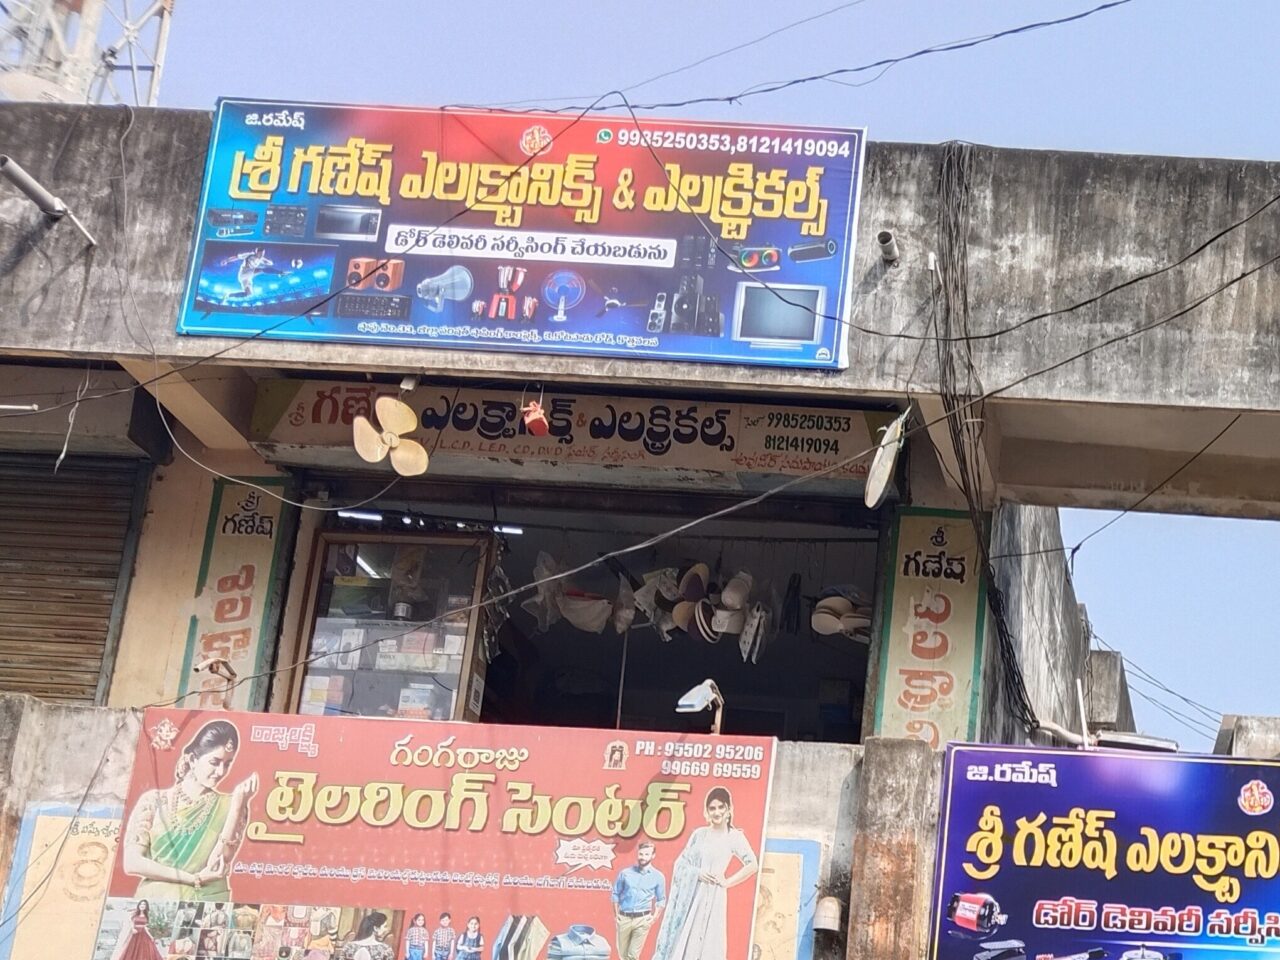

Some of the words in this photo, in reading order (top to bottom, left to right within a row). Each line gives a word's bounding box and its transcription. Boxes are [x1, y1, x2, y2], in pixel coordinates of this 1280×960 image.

[228, 135, 284, 201] శ్రీ
[286, 136, 394, 206] గణేష్
[612, 167, 636, 211] &
[432, 233, 488, 250] డెలివరీ
[491, 236, 568, 258] సర్వీసింగ్
[570, 240, 668, 261] చేయబడును
[767, 411, 852, 433] 9985250353
[765, 435, 840, 455] 8121419094
[390, 734, 530, 771] గంగరాజు
[664, 742, 712, 759] 95502
[715, 743, 764, 760] 95206
[661, 760, 710, 777] 99669
[712, 763, 761, 779] 69559
[966, 760, 1057, 787] జి.రమేష్
[246, 770, 496, 844] టైలరింగ్
[502, 780, 692, 840] సెంటర్
[962, 805, 1003, 880] శ్రీ
[1012, 807, 1118, 880] గణేష్
[1033, 896, 1096, 930] డోర్
[1102, 904, 1203, 936] డెలివరీ
